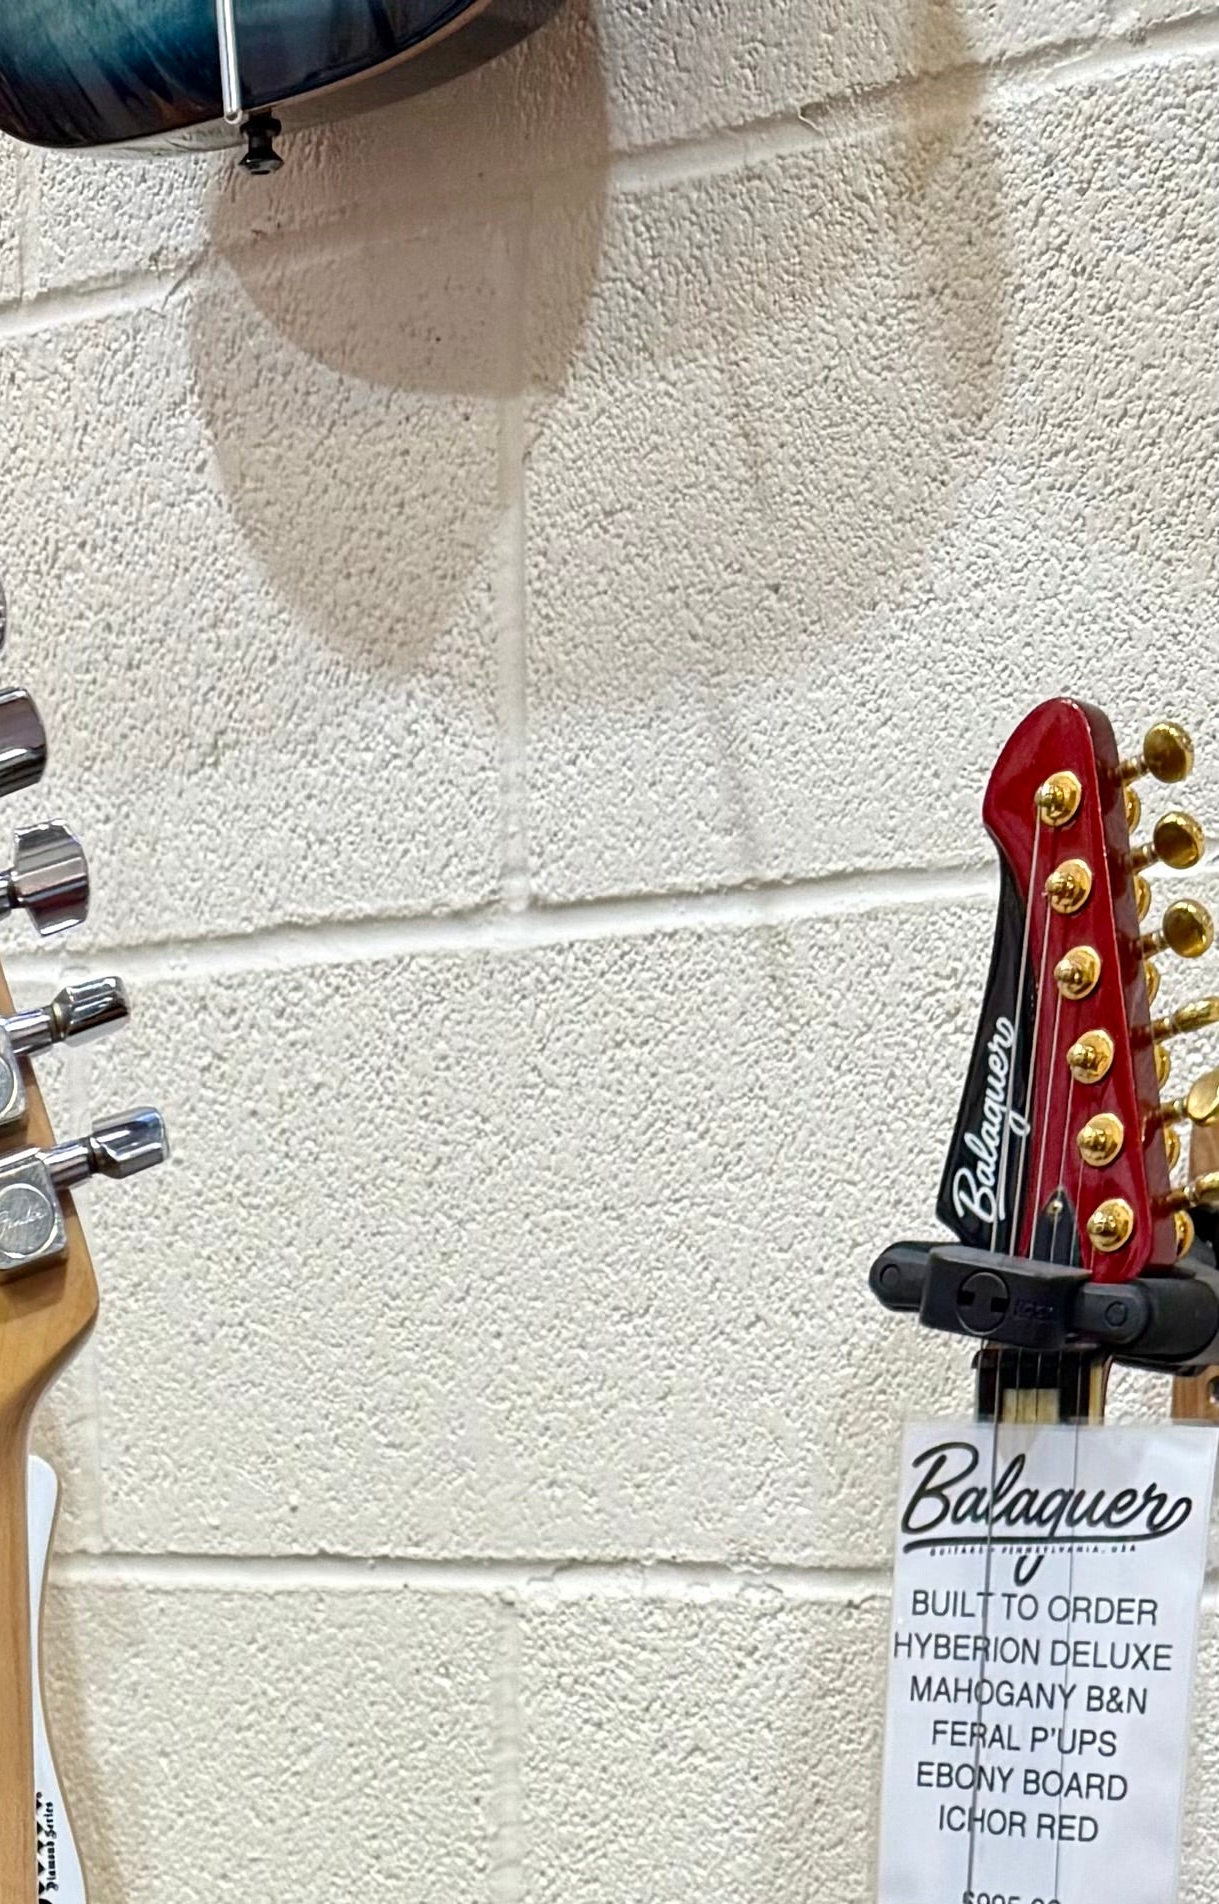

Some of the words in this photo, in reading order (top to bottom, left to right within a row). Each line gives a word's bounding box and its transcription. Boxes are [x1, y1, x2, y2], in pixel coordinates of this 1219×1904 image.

[912, 1590, 996, 1619] BUILT
[1002, 1593, 1039, 1621] TO
[1047, 1595, 1157, 1627] ORDER
[893, 1632, 1041, 1666] HYBERION
[1050, 1641, 1174, 1671] DELUXE
[910, 1676, 1077, 1710] MAHOGANY
[1086, 1686, 1148, 1714] B&N
[933, 1720, 1021, 1752] FERAL
[916, 1762, 1015, 1793] EBONY
[1022, 1770, 1128, 1801] BOARD
[939, 1805, 1028, 1838] ICHOR
[1036, 1813, 1099, 1842] RED
